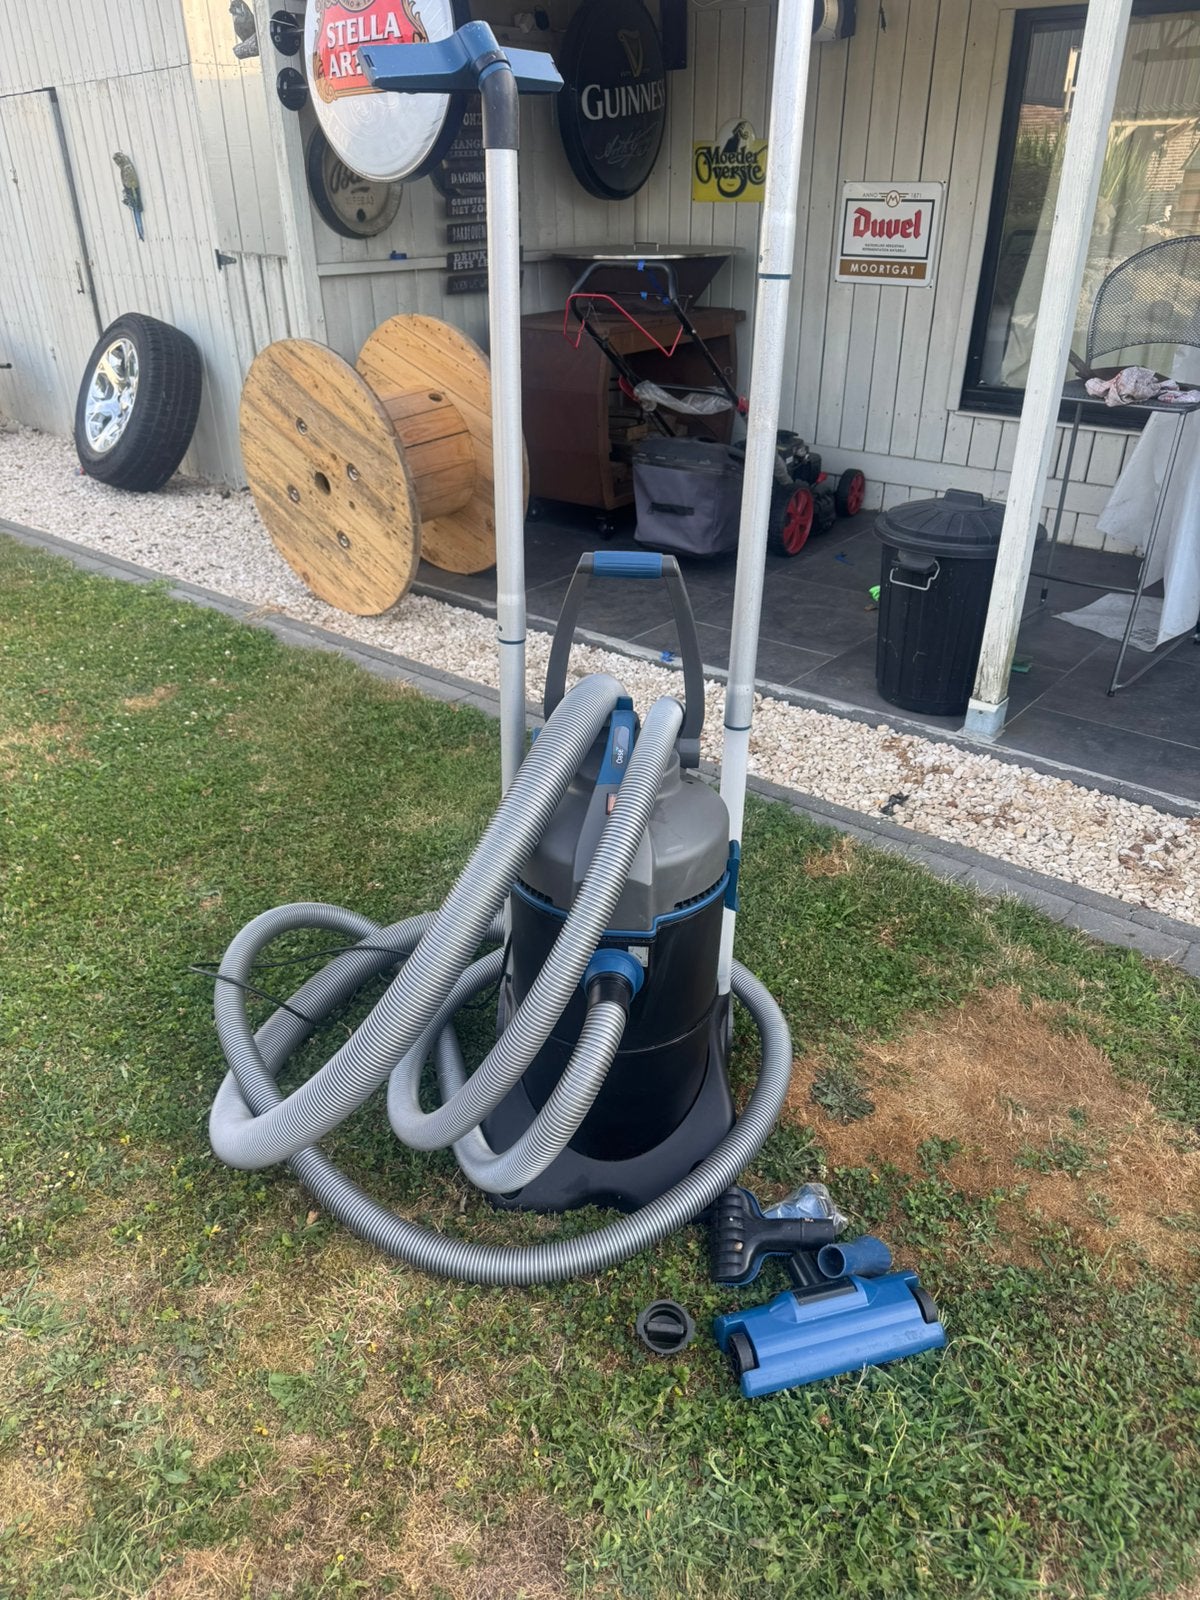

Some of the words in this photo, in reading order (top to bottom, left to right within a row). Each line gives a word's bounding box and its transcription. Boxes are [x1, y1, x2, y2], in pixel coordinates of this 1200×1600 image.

[326, 12, 402, 49] STELLA
[329, 50, 363, 78] ART
[695, 145, 768, 165] Moeder
[451, 171, 485, 184] DAGDRO
[852, 207, 922, 239] Duvel
[850, 263, 915, 275] MOORTGAT
